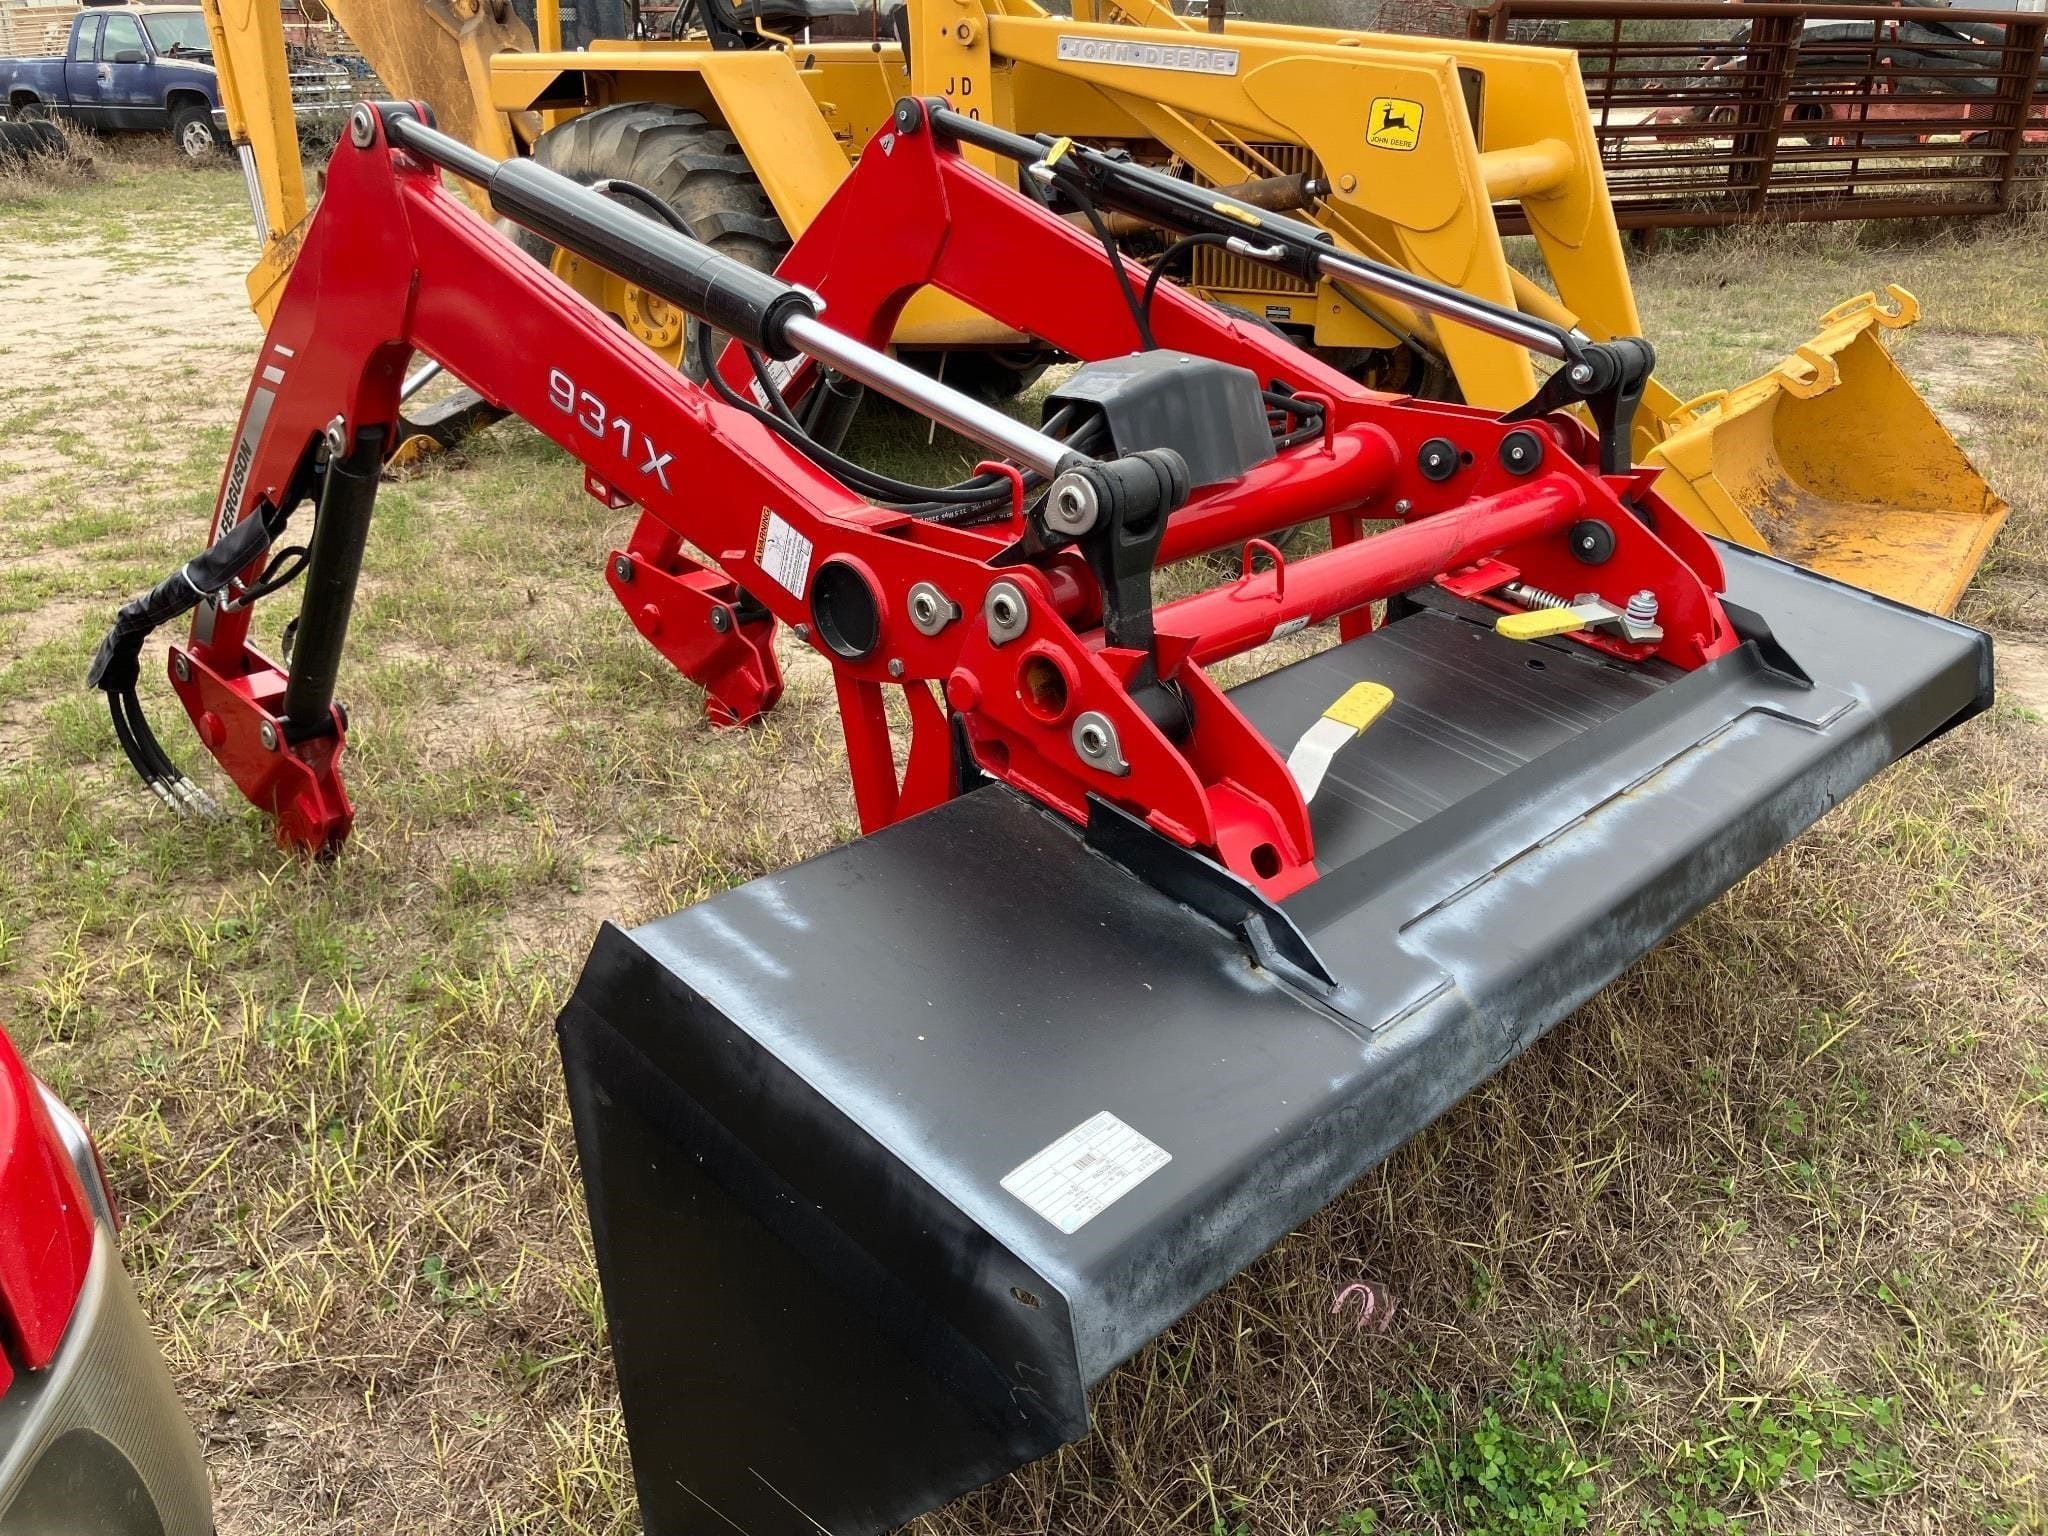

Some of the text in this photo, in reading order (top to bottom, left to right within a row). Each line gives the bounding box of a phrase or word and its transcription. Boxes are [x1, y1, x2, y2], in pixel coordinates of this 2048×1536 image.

[1070, 41, 1225, 70] JOHN DEERE
[1391, 139, 1412, 147] DEERE
[549, 367, 674, 493] 931X
[220, 438, 253, 536] FERGUSON
[757, 508, 771, 556] WARNING
